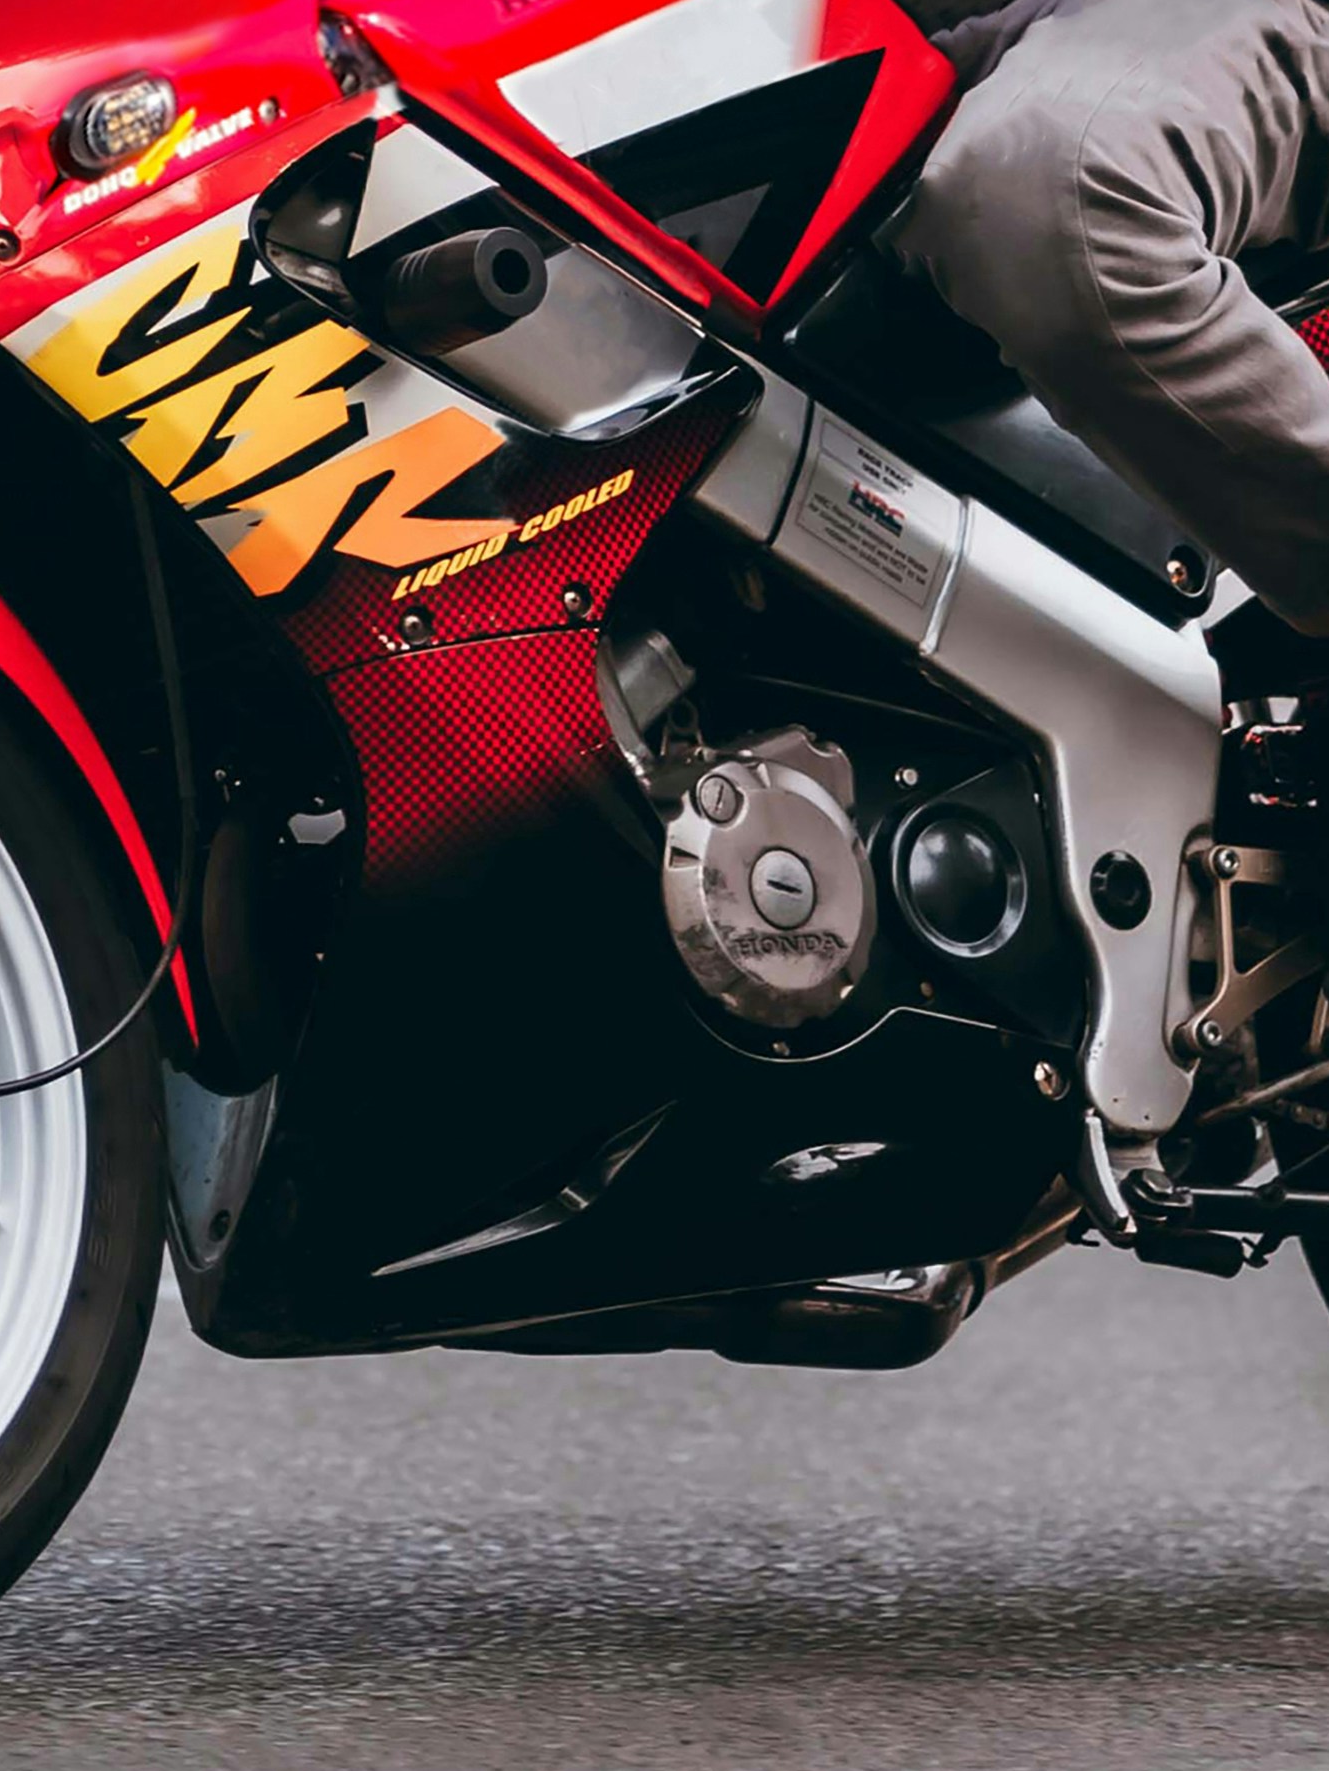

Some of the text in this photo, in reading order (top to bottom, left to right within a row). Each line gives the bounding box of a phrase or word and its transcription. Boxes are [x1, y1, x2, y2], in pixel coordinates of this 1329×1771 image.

[391, 468, 635, 601] LIQUID COOLED
[734, 930, 849, 960] HONDA
